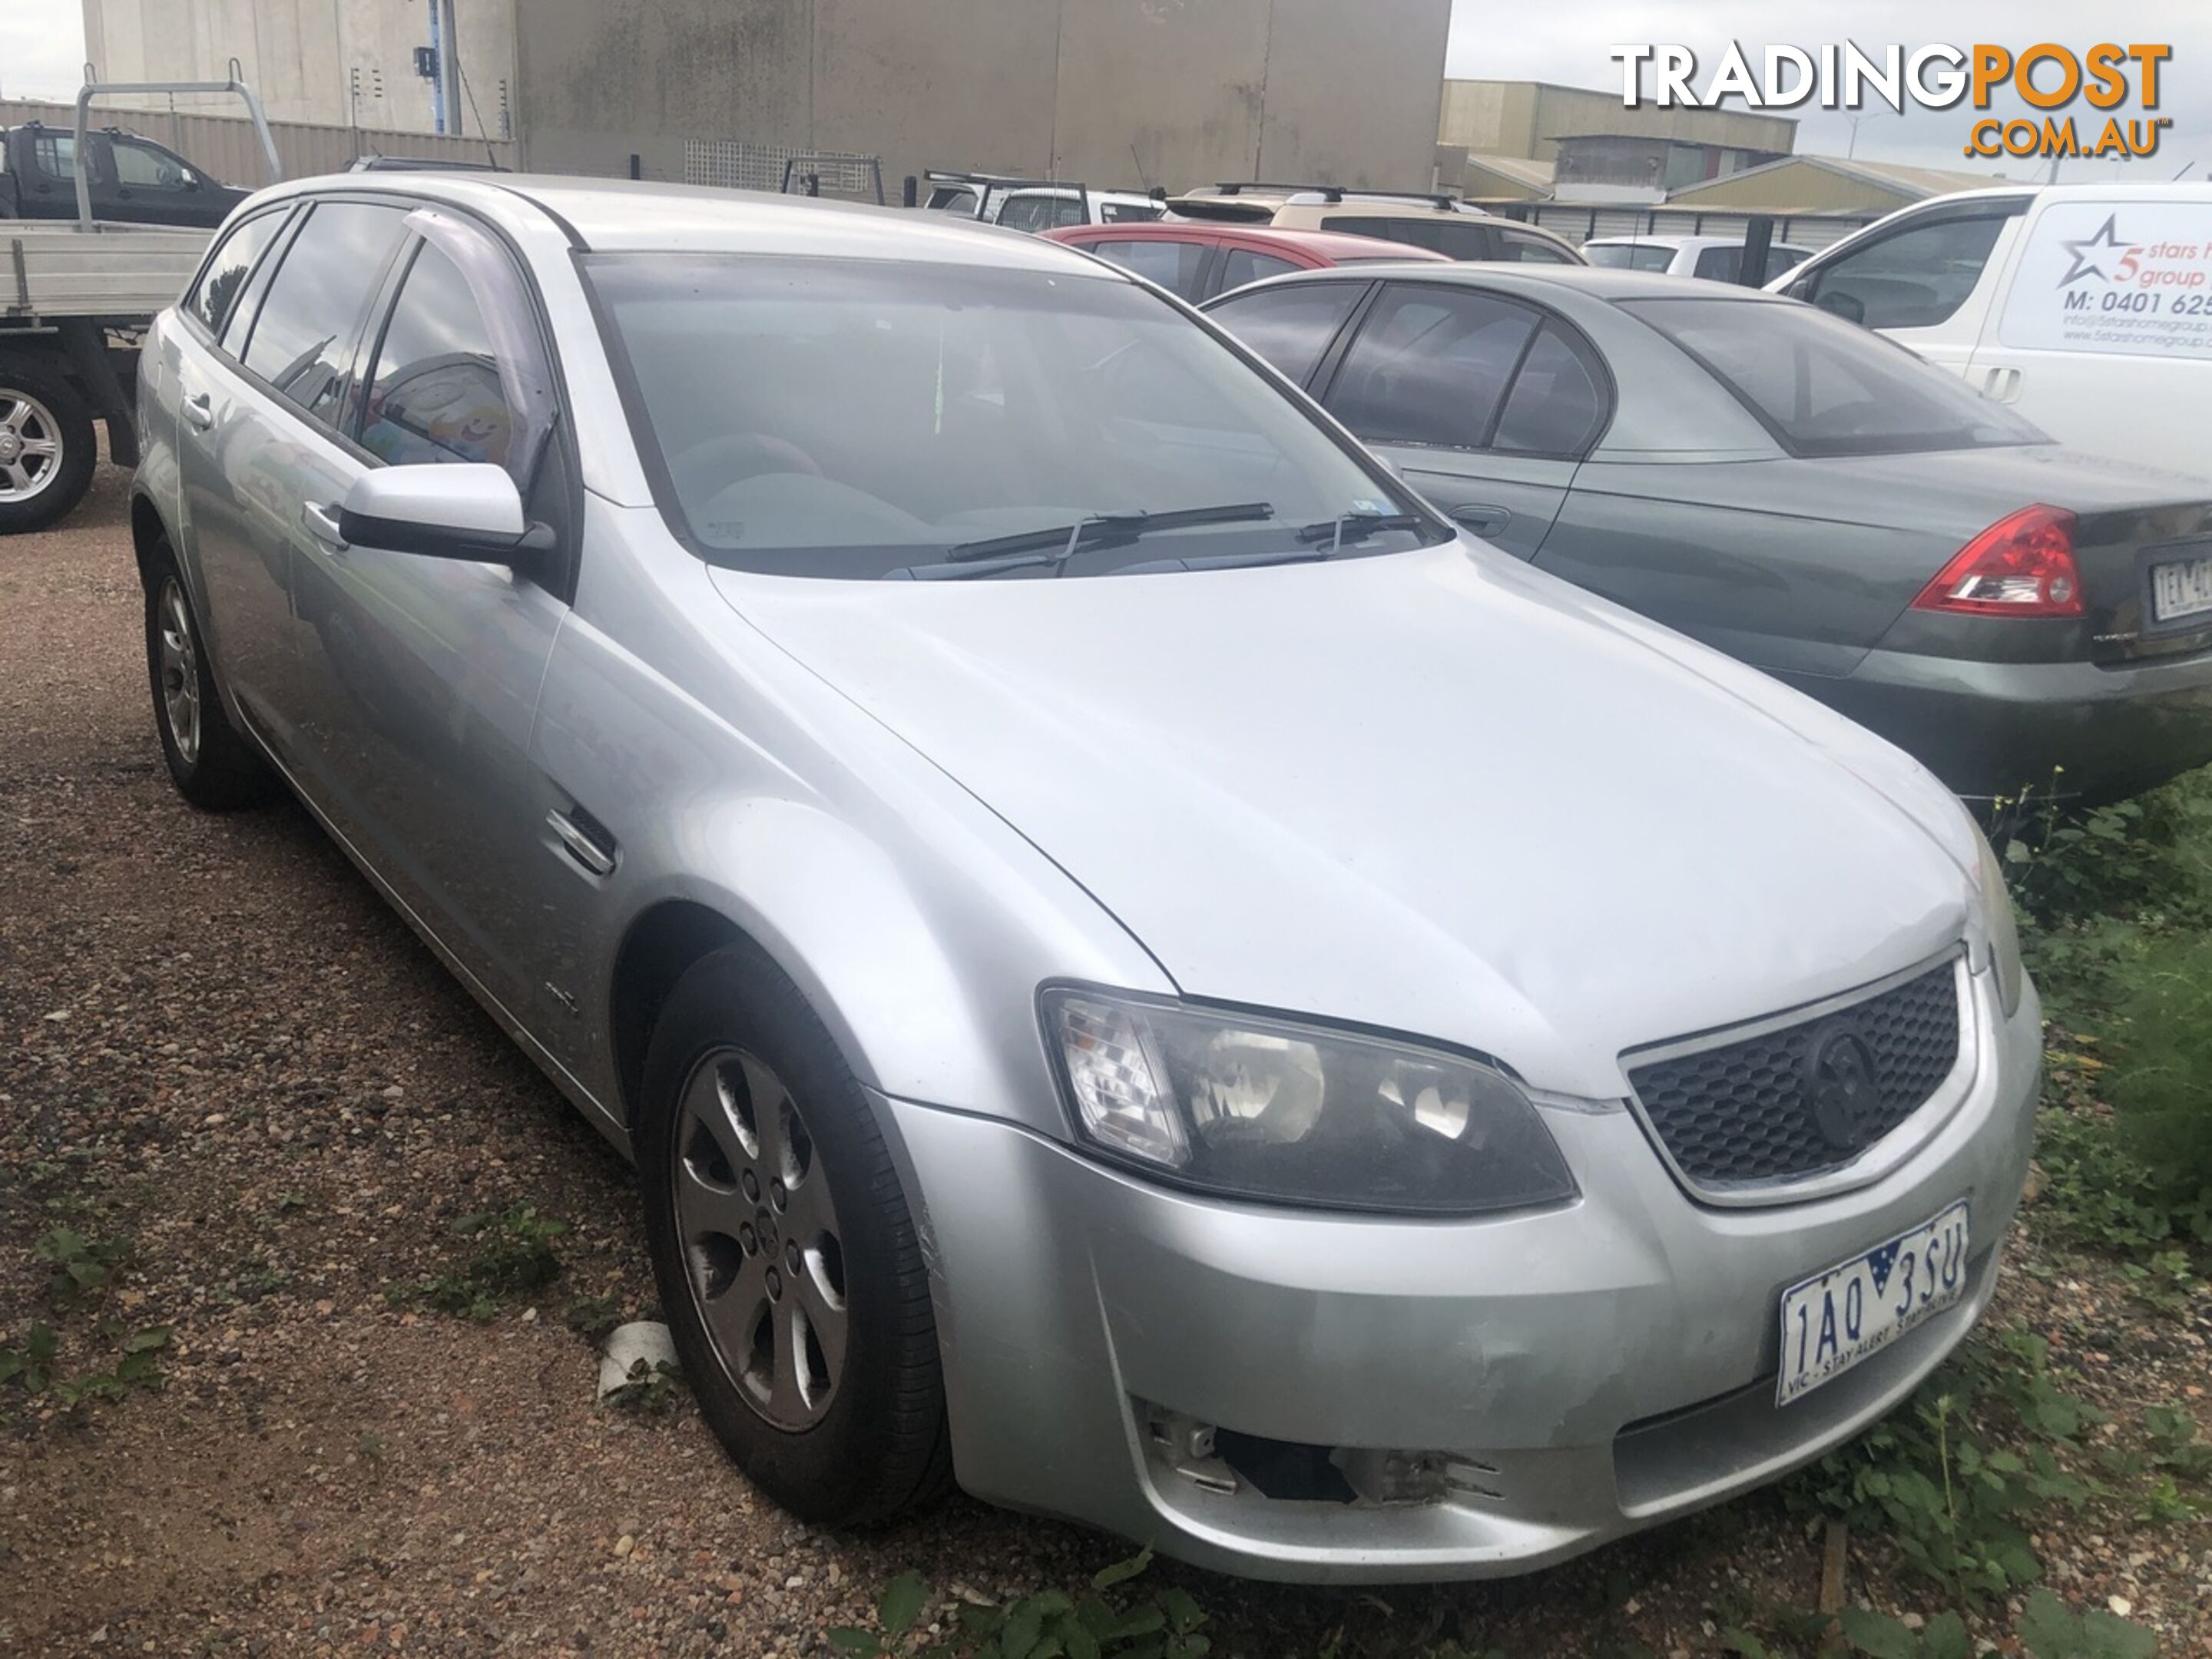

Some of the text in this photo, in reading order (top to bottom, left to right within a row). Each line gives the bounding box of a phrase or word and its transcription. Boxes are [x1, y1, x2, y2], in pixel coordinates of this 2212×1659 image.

[2114, 247, 2144, 282] 5
[2147, 241, 2198, 260] stars
[2139, 270, 2206, 289] group
[2064, 290, 2212, 316] M: 0401 625
[1788, 1372, 1810, 1395] VIC
[1823, 1346, 1856, 1376] STAY
[1854, 1326, 1889, 1356] ALERT
